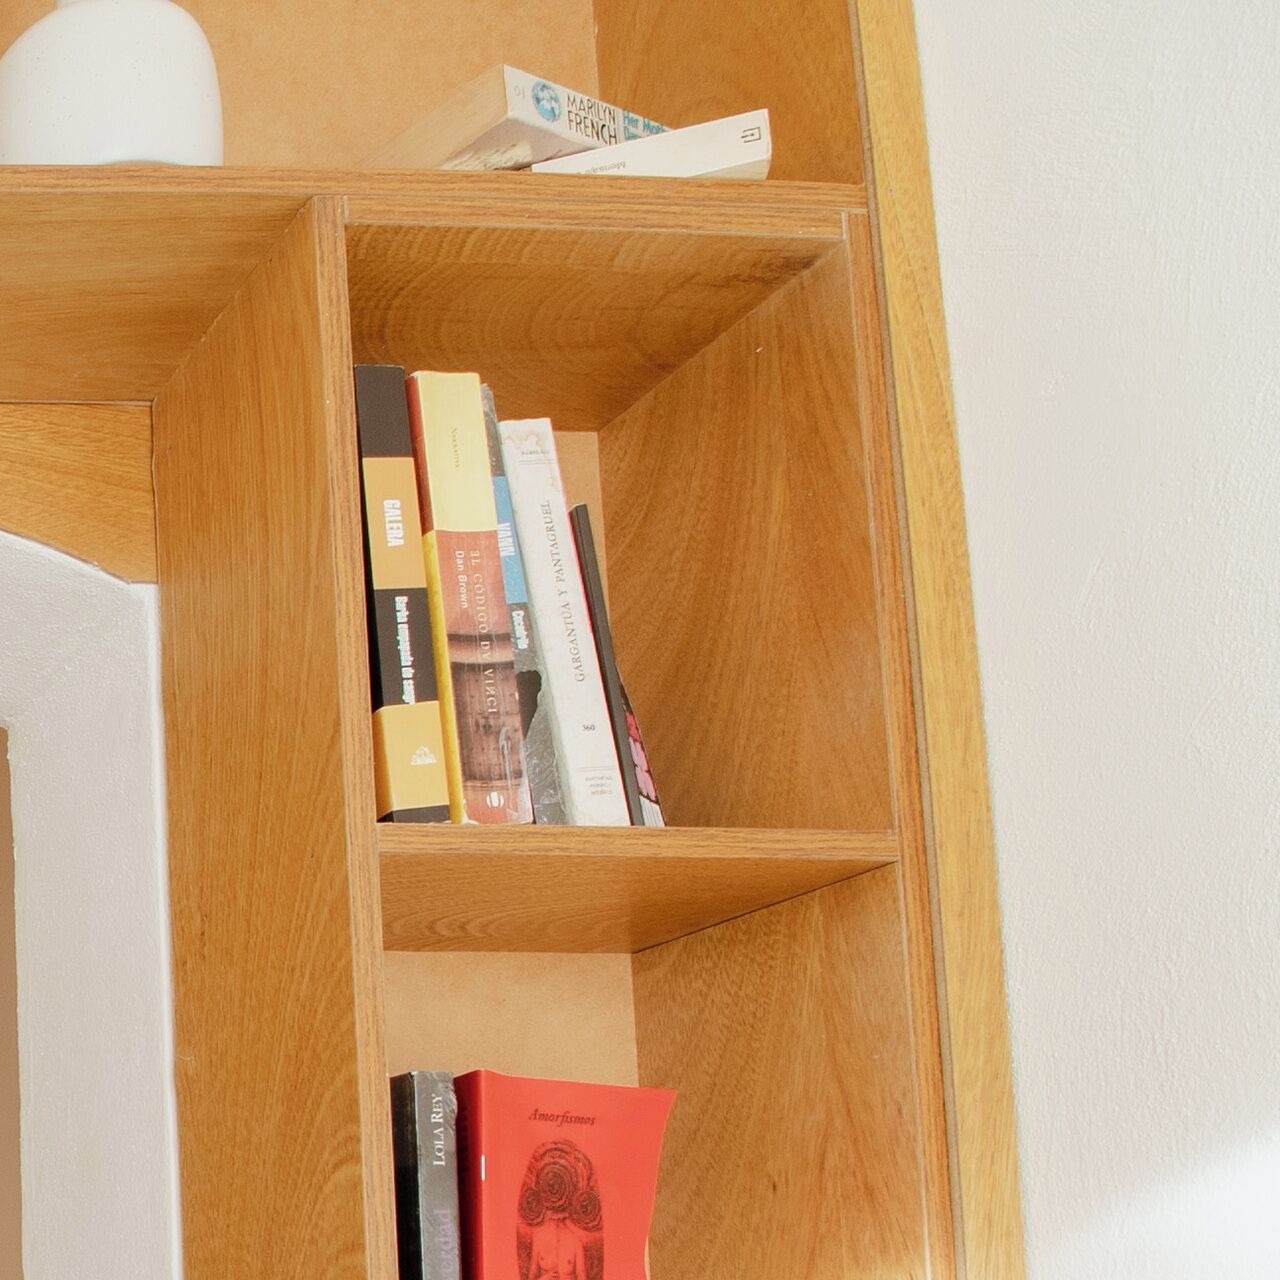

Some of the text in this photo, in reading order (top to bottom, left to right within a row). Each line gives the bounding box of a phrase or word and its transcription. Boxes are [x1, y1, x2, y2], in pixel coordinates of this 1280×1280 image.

[566, 94, 617, 124] MARILYN
[566, 110, 618, 146] FRENCH
[383, 499, 406, 549] GALERA
[497, 523, 517, 557] VANN
[540, 500, 566, 584] PANTAGRUEL
[455, 550, 469, 609] Dan Brown
[473, 573, 489, 634] CÓDIGO
[401, 666, 415, 679] de
[430, 1093, 446, 1167] LOLA REY
[528, 1107, 597, 1128] Amorfismos
